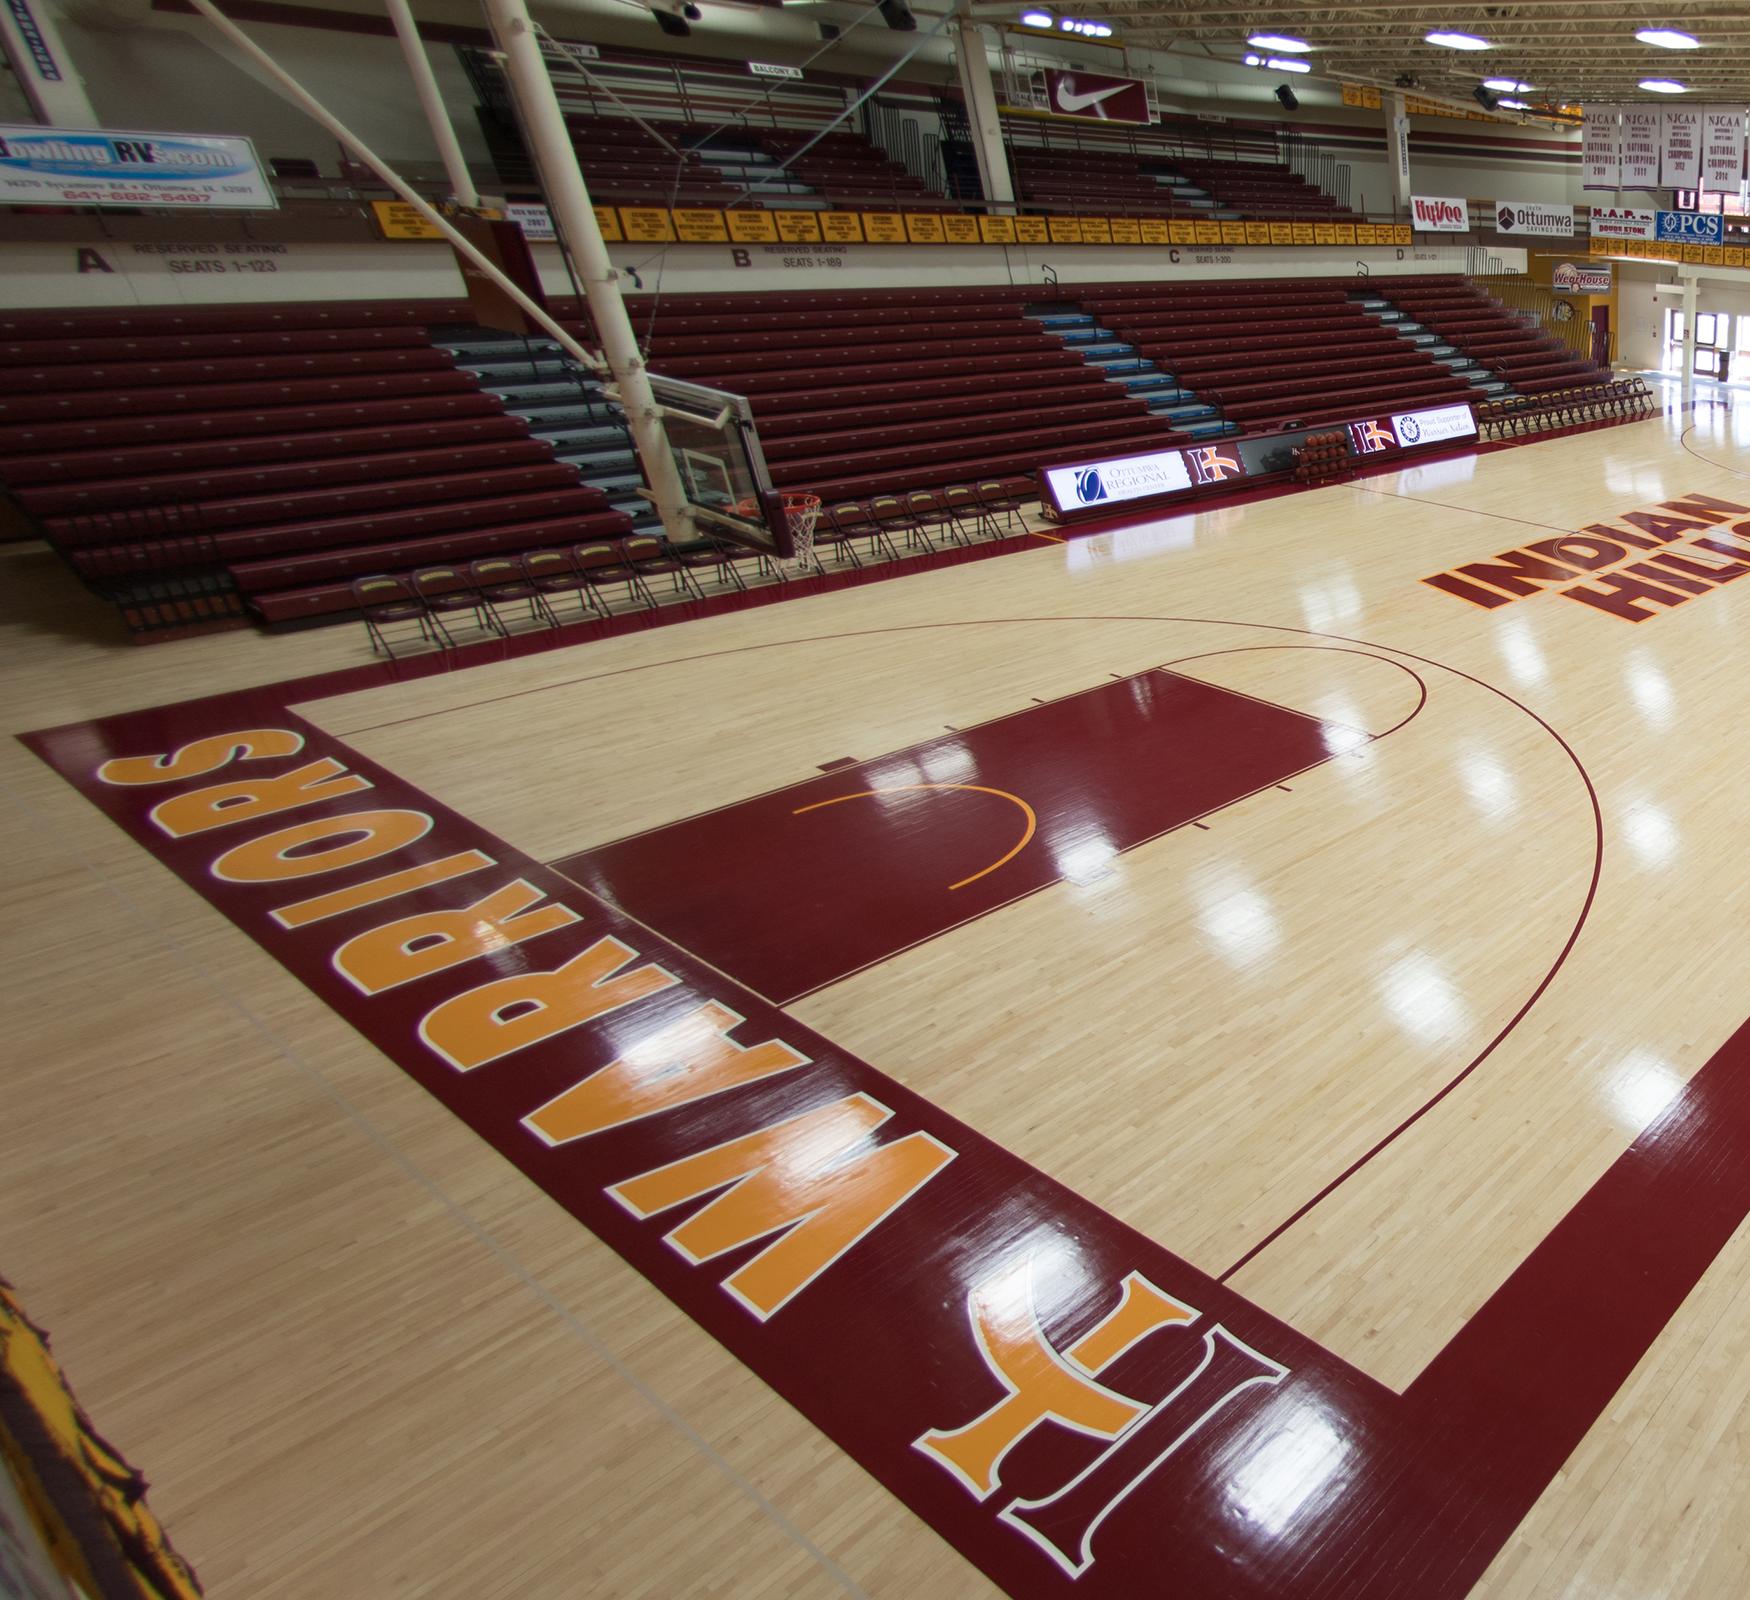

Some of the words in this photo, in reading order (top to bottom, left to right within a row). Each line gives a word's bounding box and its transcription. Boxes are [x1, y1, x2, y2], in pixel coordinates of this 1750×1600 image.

[753, 64, 790, 76] BALCONY
[1585, 113, 1616, 125] NJCAA
[1625, 113, 1656, 125] NJCAA
[1667, 113, 1696, 124] NJCAA
[1708, 116, 1740, 127] NJCAA
[1585, 155, 1616, 165] CHAMPIONS
[1625, 155, 1656, 165] CHAMPIONS
[1668, 150, 1693, 159] CHAMPIONS
[1708, 159, 1738, 169] CHAMPIONS
[1517, 208, 1572, 227] Ottumwa
[1679, 214, 1719, 236] PCS
[134, 243, 219, 254] RESERVED
[225, 244, 287, 254] SEATING
[764, 246, 810, 254] RESERVED
[812, 246, 847, 254] SEATING
[78, 247, 114, 273] A
[732, 249, 752, 268] B
[1169, 249, 1180, 264] C
[1196, 255, 1214, 264] SEATS
[1215, 255, 1232, 263] 1-200
[1397, 249, 1404, 261] D
[168, 260, 226, 273] SEATS
[233, 260, 277, 273] 1-123
[783, 257, 814, 268] SEATS
[1554, 273, 1609, 285] WearHouse
[1105, 470, 1172, 491] REGIONAL
[95, 727, 960, 1322] WARRIORS
